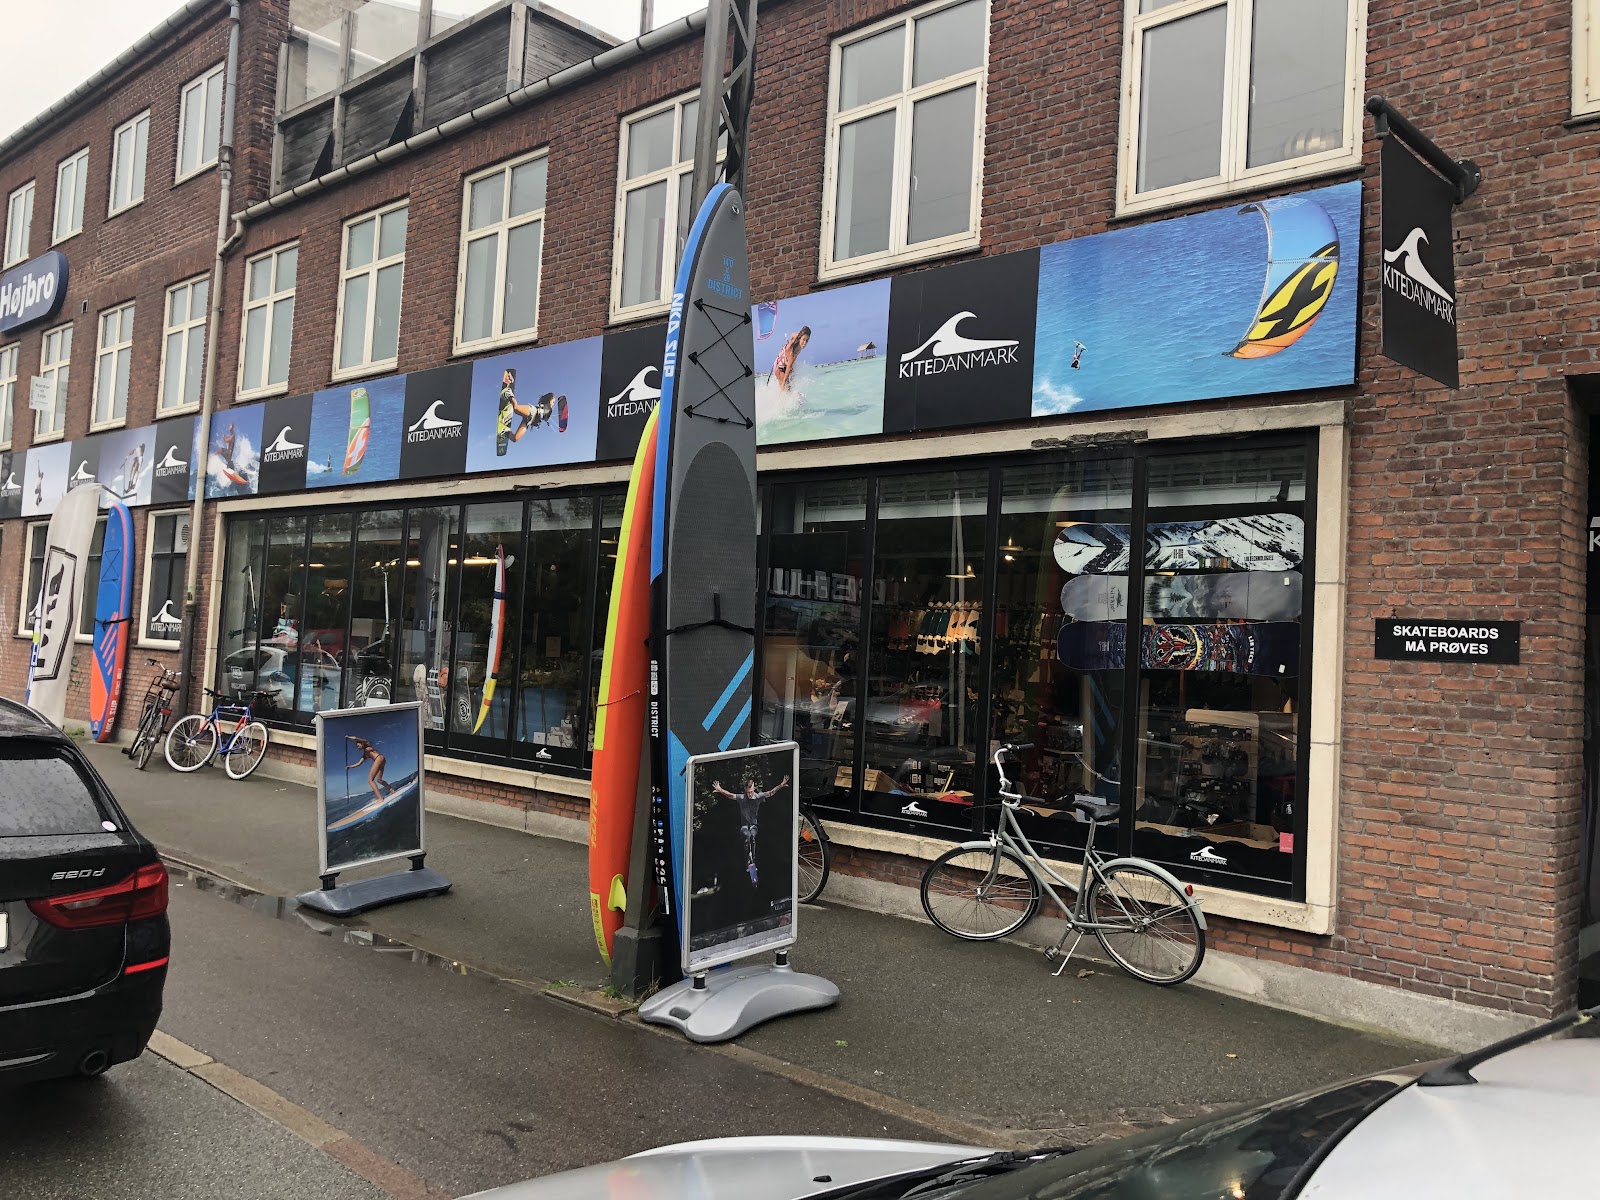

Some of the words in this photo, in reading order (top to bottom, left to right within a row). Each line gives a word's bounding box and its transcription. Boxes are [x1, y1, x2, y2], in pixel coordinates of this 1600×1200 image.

[0, 271, 54, 318] Højbro
[707, 279, 743, 299] DISTRICT
[1383, 262, 1455, 326] KITEDANMARK
[664, 339, 677, 378] SUP
[899, 345, 1018, 379] KITEDANMARK
[607, 399, 659, 418] KITEDAN
[407, 426, 462, 443] KITEDANMARK
[264, 448, 304, 462] KITEDANMARK
[156, 465, 187, 477] KITEDANMARK
[1393, 625, 1499, 639] SKATEBOARDS
[1405, 640, 1427, 653] MÅ
[1430, 641, 1489, 654] PRØVES
